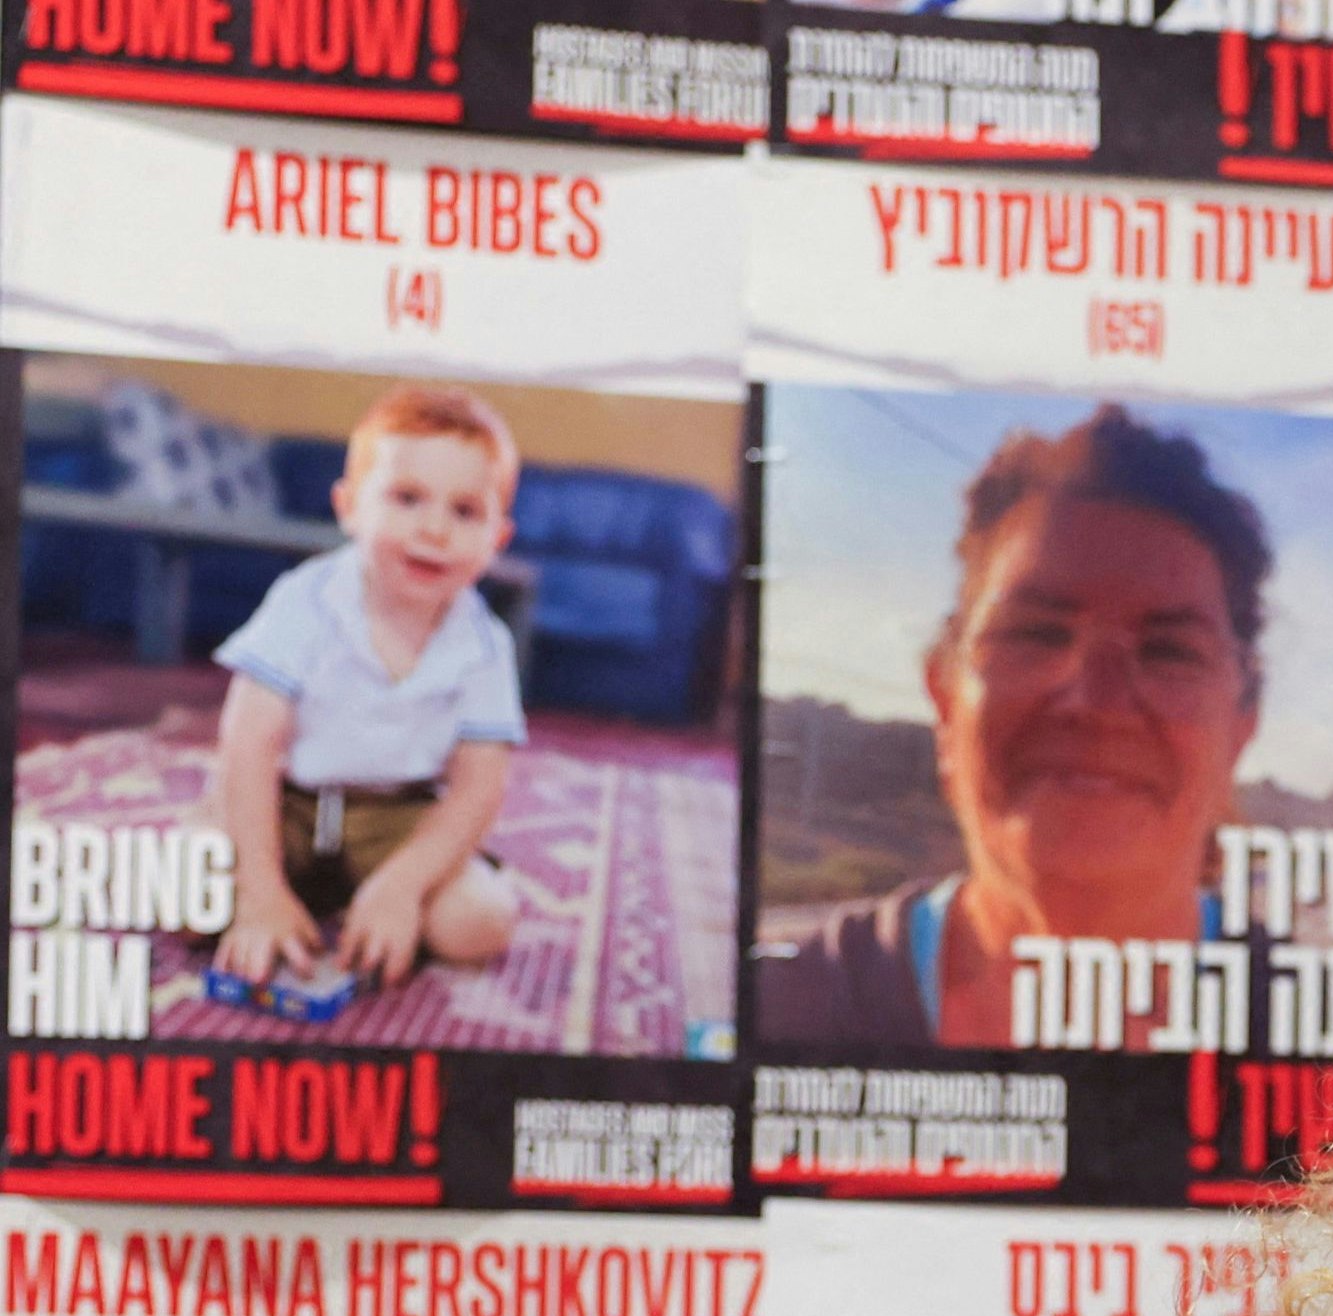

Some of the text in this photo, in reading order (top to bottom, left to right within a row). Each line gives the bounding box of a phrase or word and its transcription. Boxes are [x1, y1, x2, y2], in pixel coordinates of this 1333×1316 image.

[250, 0, 462, 85] NOW!
[223, 146, 604, 263] ARIEL BIBES
[869, 182, 1169, 282] הרשקוביץ
[383, 267, 445, 332] (4)
[1088, 297, 1167, 360] (65)
[12, 826, 234, 934] BRING
[8, 929, 152, 1041] HIM
[1012, 935, 1253, 1055] הביתה
[7, 1051, 442, 1167] HOME NOW!
